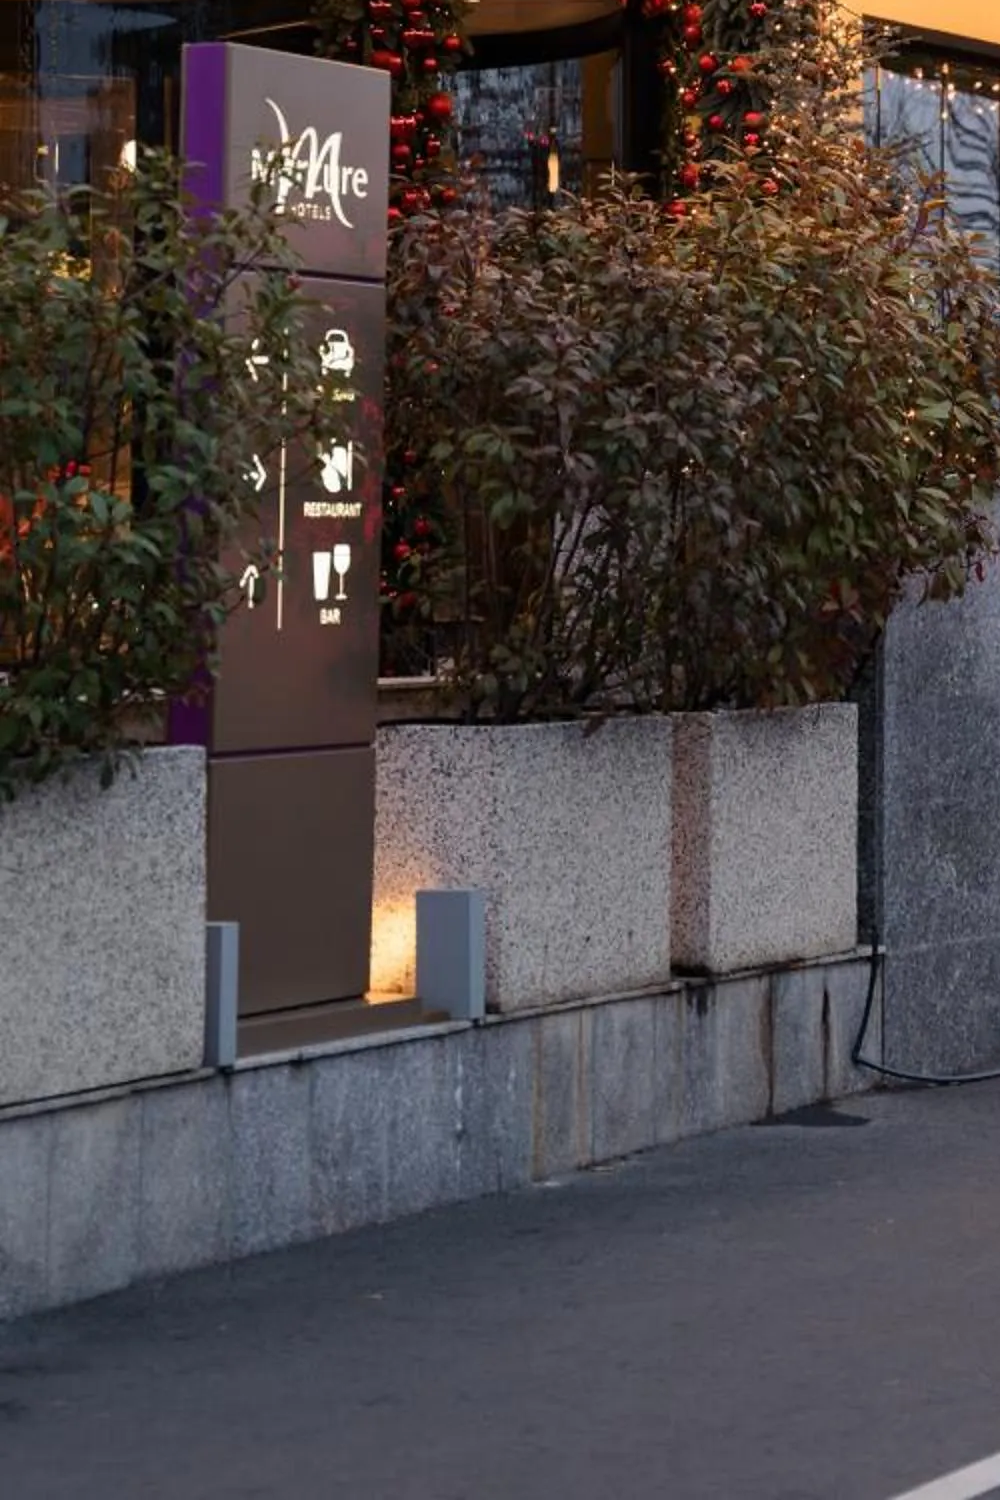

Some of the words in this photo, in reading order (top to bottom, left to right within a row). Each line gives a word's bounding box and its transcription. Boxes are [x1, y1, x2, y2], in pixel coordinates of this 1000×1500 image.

[291, 202, 331, 220] OTELS
[303, 501, 362, 517] RESTAURANT
[320, 608, 341, 625] BAR
